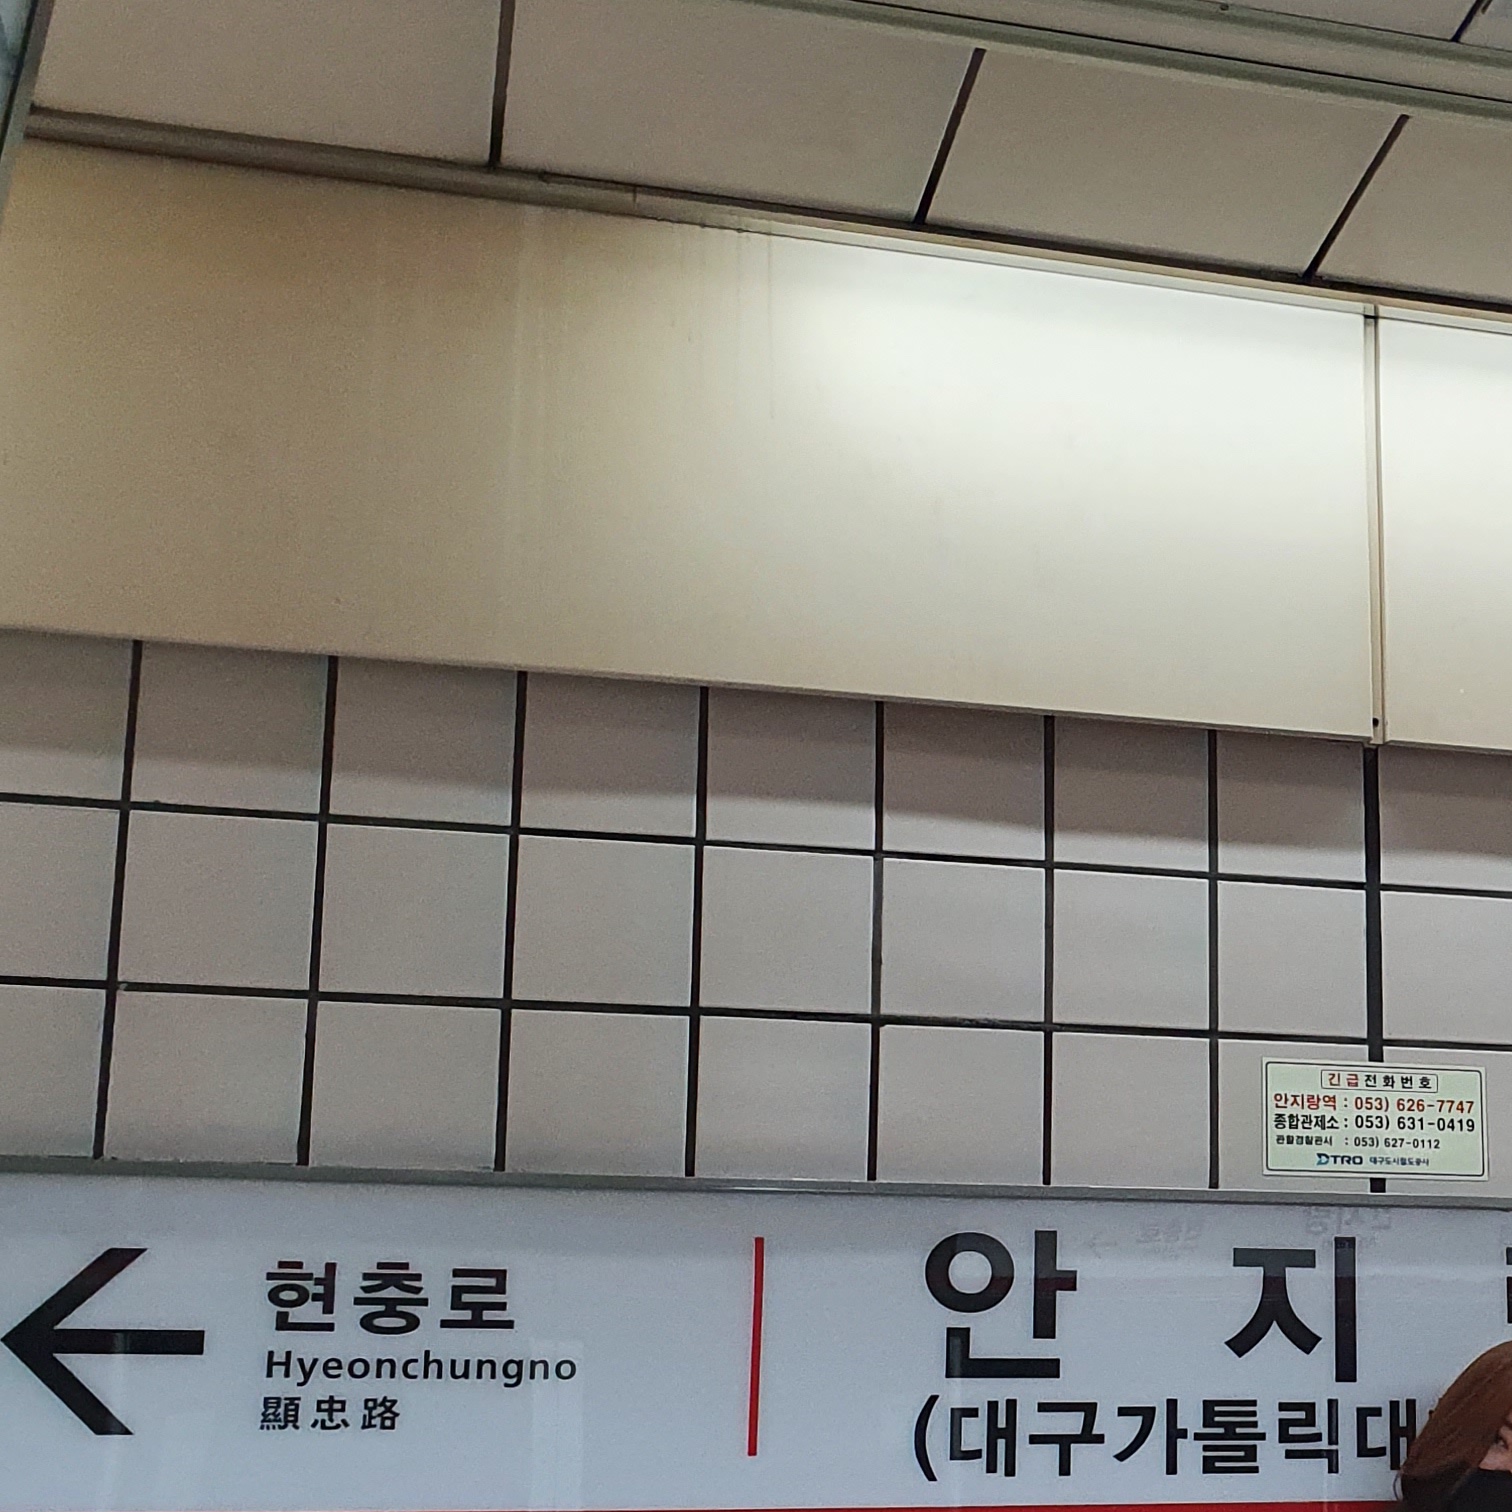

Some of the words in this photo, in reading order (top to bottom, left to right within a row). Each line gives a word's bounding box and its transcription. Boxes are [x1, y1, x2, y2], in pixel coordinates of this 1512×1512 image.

[1273, 1093, 1337, 1111] 안지랑역
[1354, 1096, 1390, 1113] 053)
[1396, 1098, 1475, 1115] 626-7747
[1273, 1113, 1340, 1131] 종합관제소
[1354, 1114, 1390, 1131] 053)
[1397, 1116, 1475, 1133] 631-0419
[1353, 1136, 1380, 1148] 053)
[1384, 1137, 1440, 1150] 627-0112
[1316, 1152, 1364, 1166] DTRO
[266, 1260, 515, 1336] 현충로
[265, 1349, 578, 1389] Hyeonchungno
[259, 1394, 401, 1431] 顯忠路
